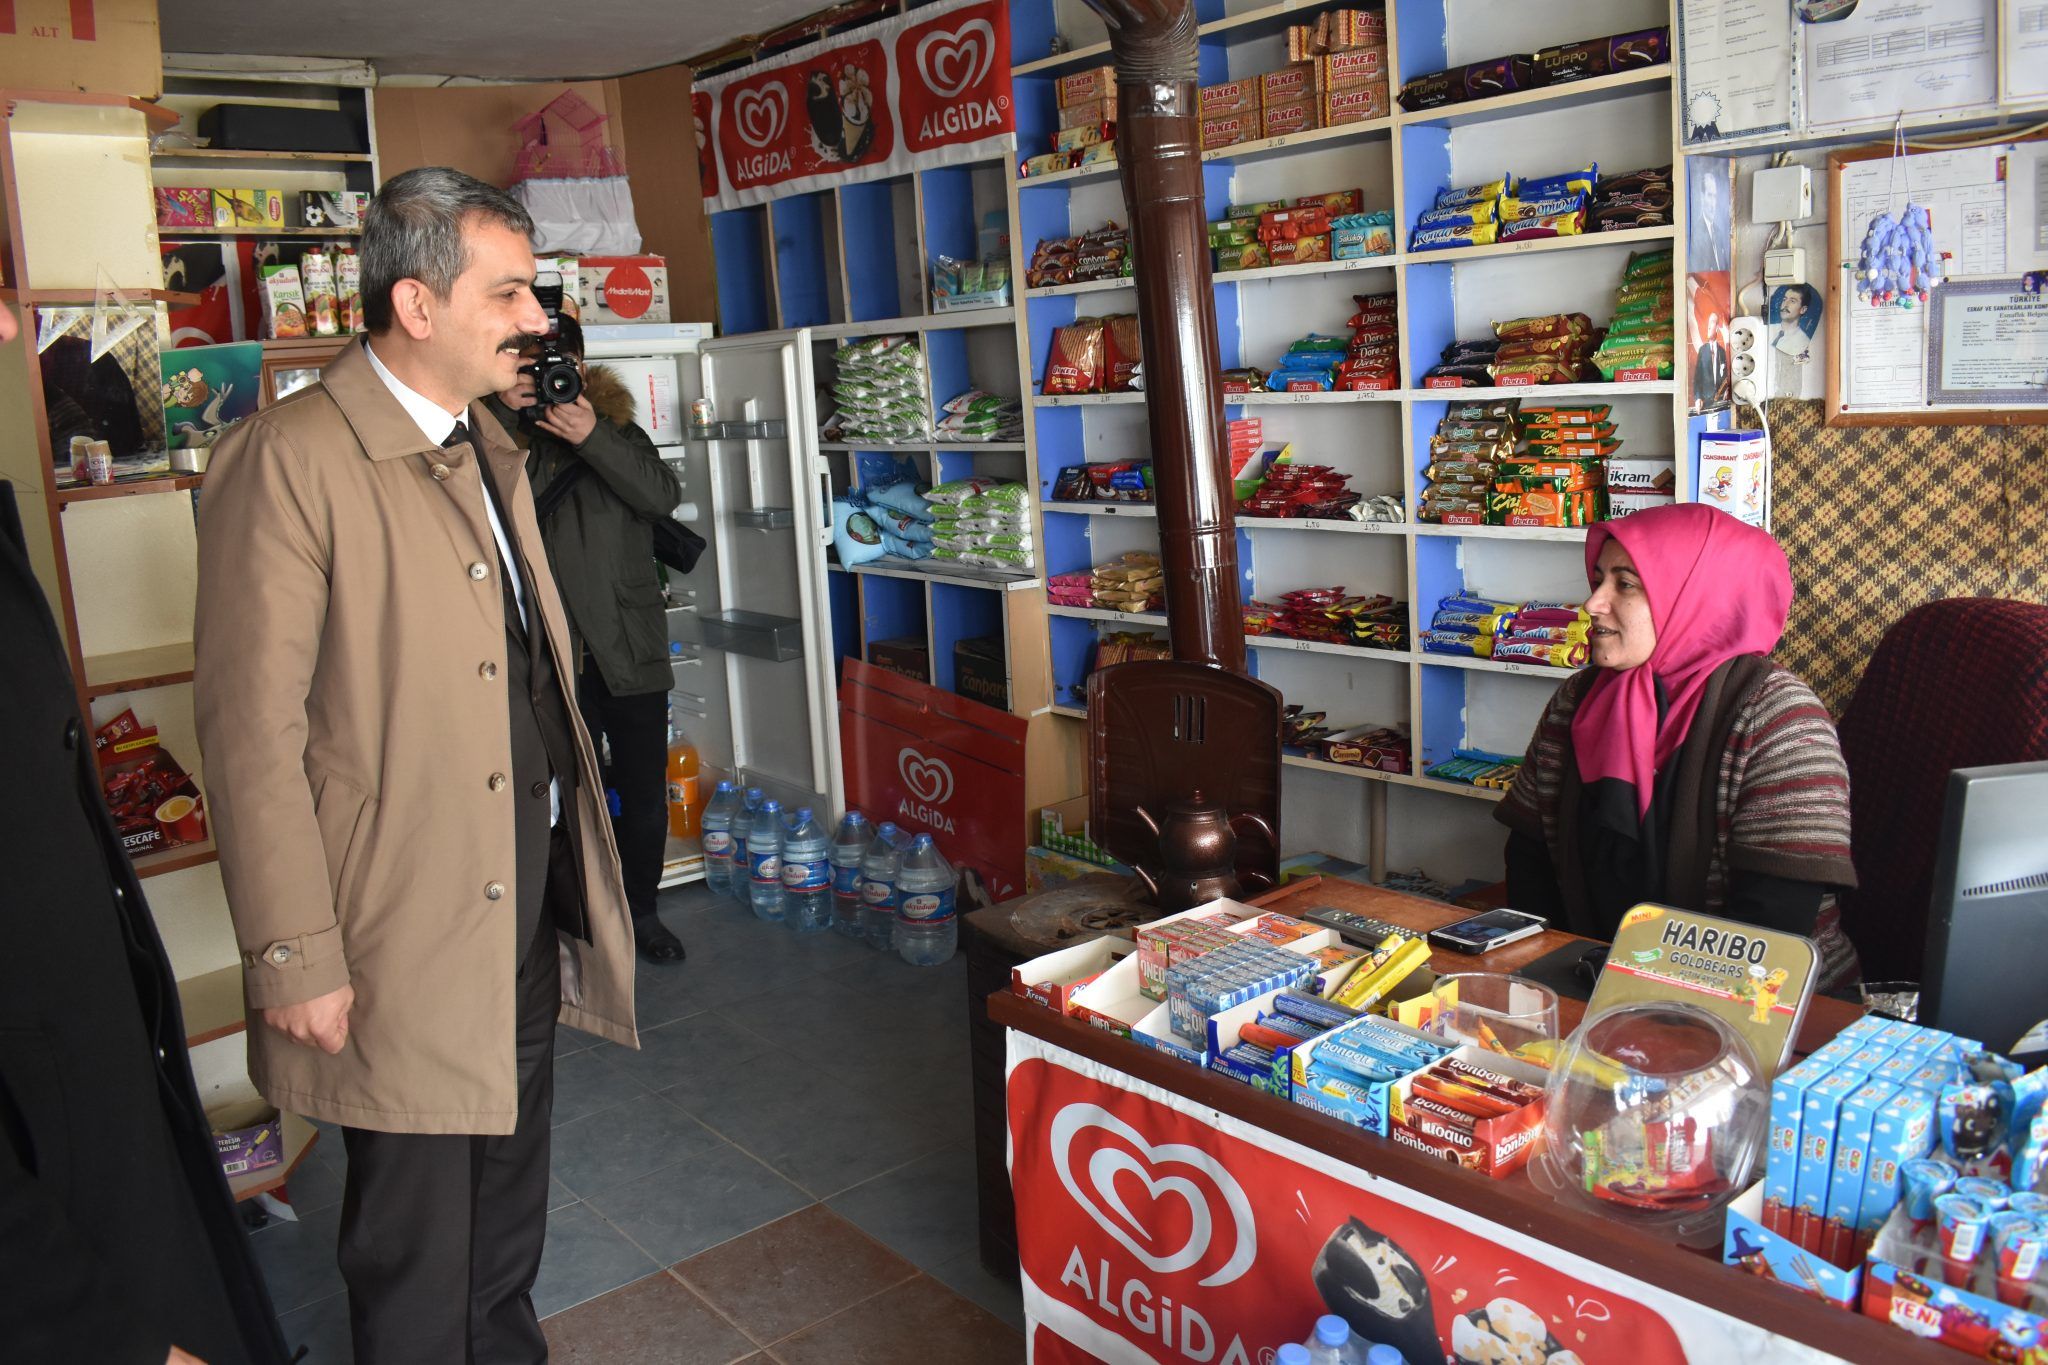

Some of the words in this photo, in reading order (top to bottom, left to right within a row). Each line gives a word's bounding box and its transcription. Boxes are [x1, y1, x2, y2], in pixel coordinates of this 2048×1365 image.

[32, 26, 59, 38] ALT
[1332, 52, 1377, 69] ÜLKER
[1545, 51, 1588, 68] LUPPO
[1066, 75, 1093, 89] ÜLKER
[1267, 72, 1302, 88] ÜLKER
[1202, 85, 1238, 101] ÜLKER
[1414, 81, 1448, 96] LUPPO
[1331, 91, 1371, 108] ÜLKER
[919, 99, 1003, 142] ALGiDA
[1267, 107, 1303, 123] ÜLKER
[1203, 120, 1239, 136] ÜLKER
[736, 151, 791, 181] ALGiDA
[1421, 208, 1454, 223] Rondo
[1502, 218, 1540, 238] Rondo
[1414, 227, 1453, 246] Rondo
[1368, 297, 1387, 309] Dore
[1362, 313, 1382, 325] Dore
[1363, 333, 1384, 344] Dore
[1360, 347, 1380, 359] Dore
[1052, 364, 1078, 376] ÜLKER
[1623, 371, 1651, 381] ÜLKER
[1432, 379, 1456, 388] ÜLKER
[1502, 377, 1527, 386] ÜLKER
[1609, 470, 1650, 483] ikram
[1448, 515, 1472, 524] ÜLKER
[1513, 516, 1538, 525] ÜLKER
[1495, 643, 1531, 656] Rondo
[899, 797, 956, 835] ALGiDA
[124, 831, 160, 847] ESCAFE
[1631, 912, 1652, 922] MINI
[1662, 919, 1767, 965] HARIBO
[1140, 960, 1166, 983] ONEO
[1670, 952, 1744, 979] GOLDBEARS
[1292, 1068, 1302, 1080] 75
[1449, 1059, 1506, 1084] bonbon
[1296, 1092, 1343, 1119] bonbon
[1391, 1104, 1400, 1115] 75
[1413, 1098, 1471, 1122] bonbon
[1393, 1129, 1443, 1158] bonbon
[1496, 1126, 1540, 1160] bonbon
[1060, 1245, 1250, 1365] ALGiDA
